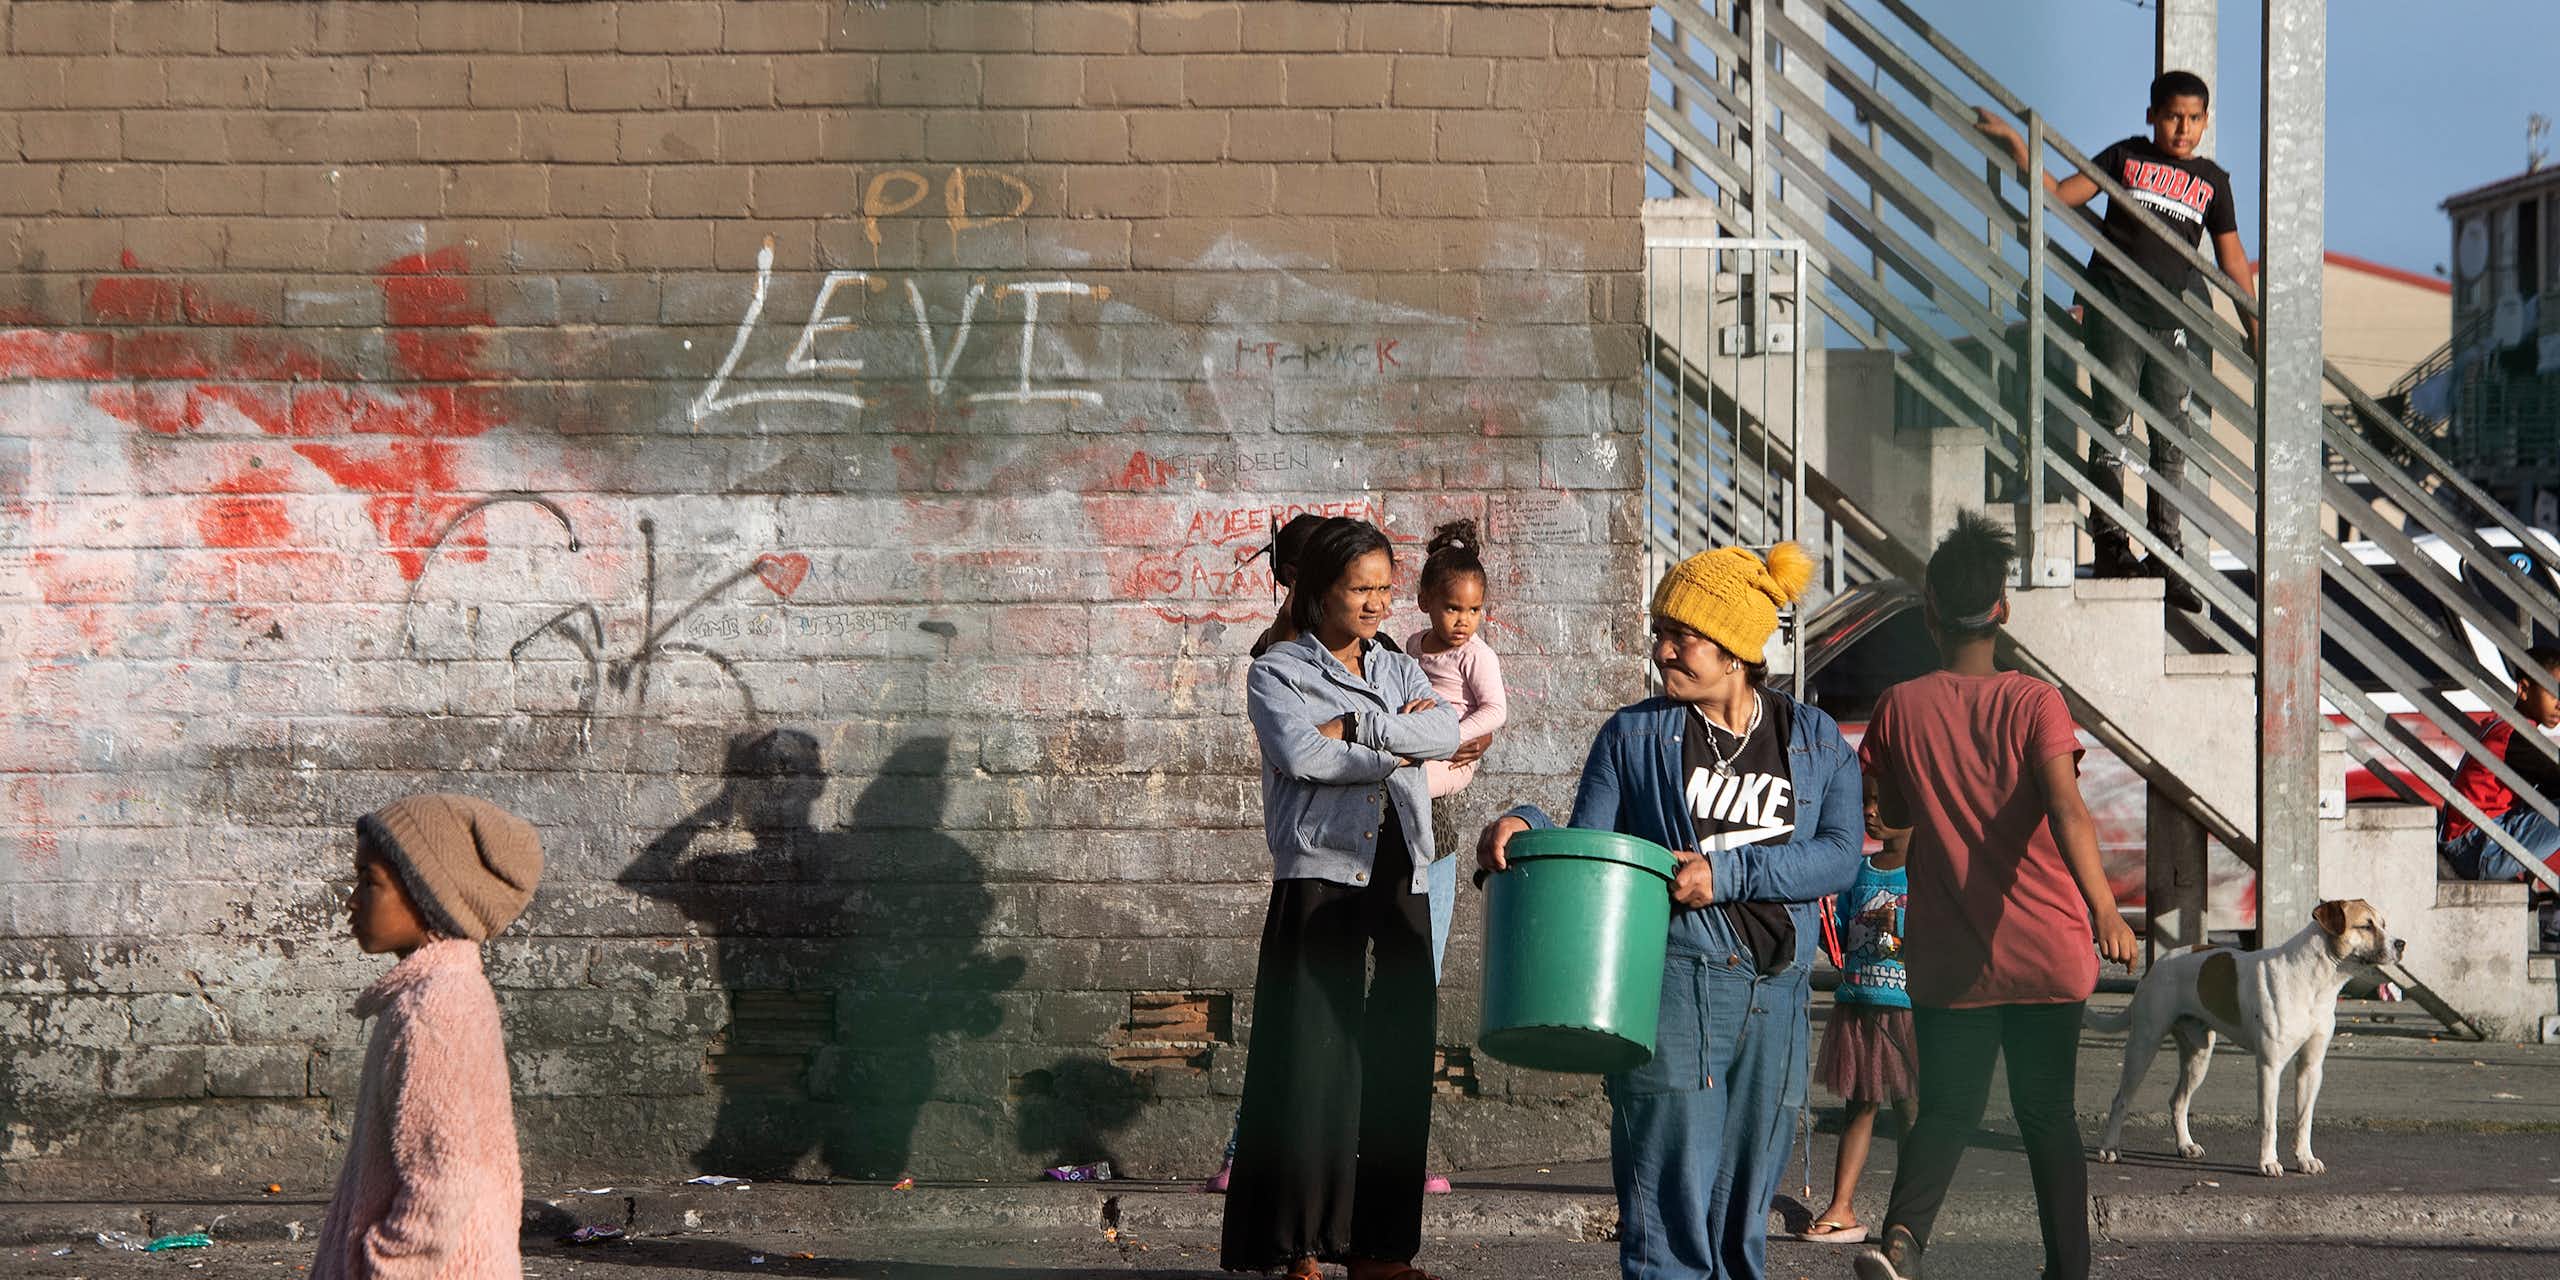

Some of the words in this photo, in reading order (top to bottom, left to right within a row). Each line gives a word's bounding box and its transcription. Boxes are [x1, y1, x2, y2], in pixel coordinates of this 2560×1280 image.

[2123, 159, 2214, 213] REDBAT
[687, 236, 1108, 430] LEVI
[1686, 766, 1792, 828] NIKE
[1861, 963, 1907, 980] HELLO
[1861, 975, 1907, 991] KITTY
